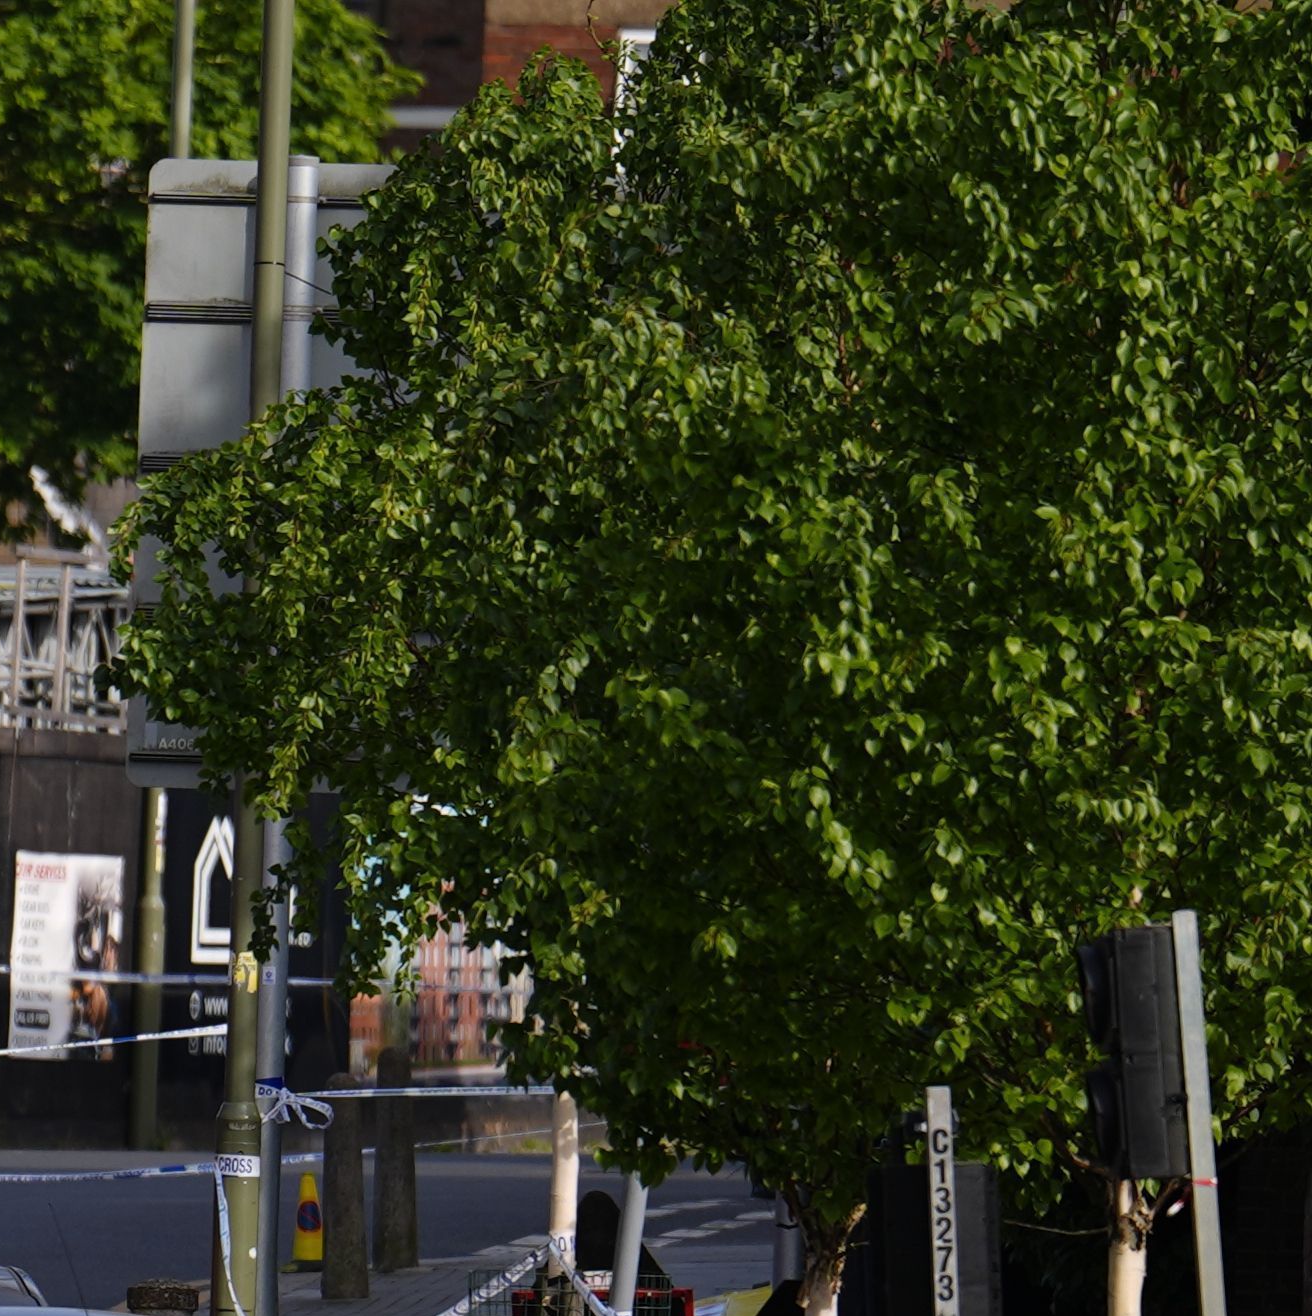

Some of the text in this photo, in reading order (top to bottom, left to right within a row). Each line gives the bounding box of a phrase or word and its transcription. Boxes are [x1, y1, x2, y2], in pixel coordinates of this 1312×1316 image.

[258, 1087, 273, 1096] DO
[218, 1157, 252, 1173] CROSS
[932, 1129, 954, 1302] C13273
